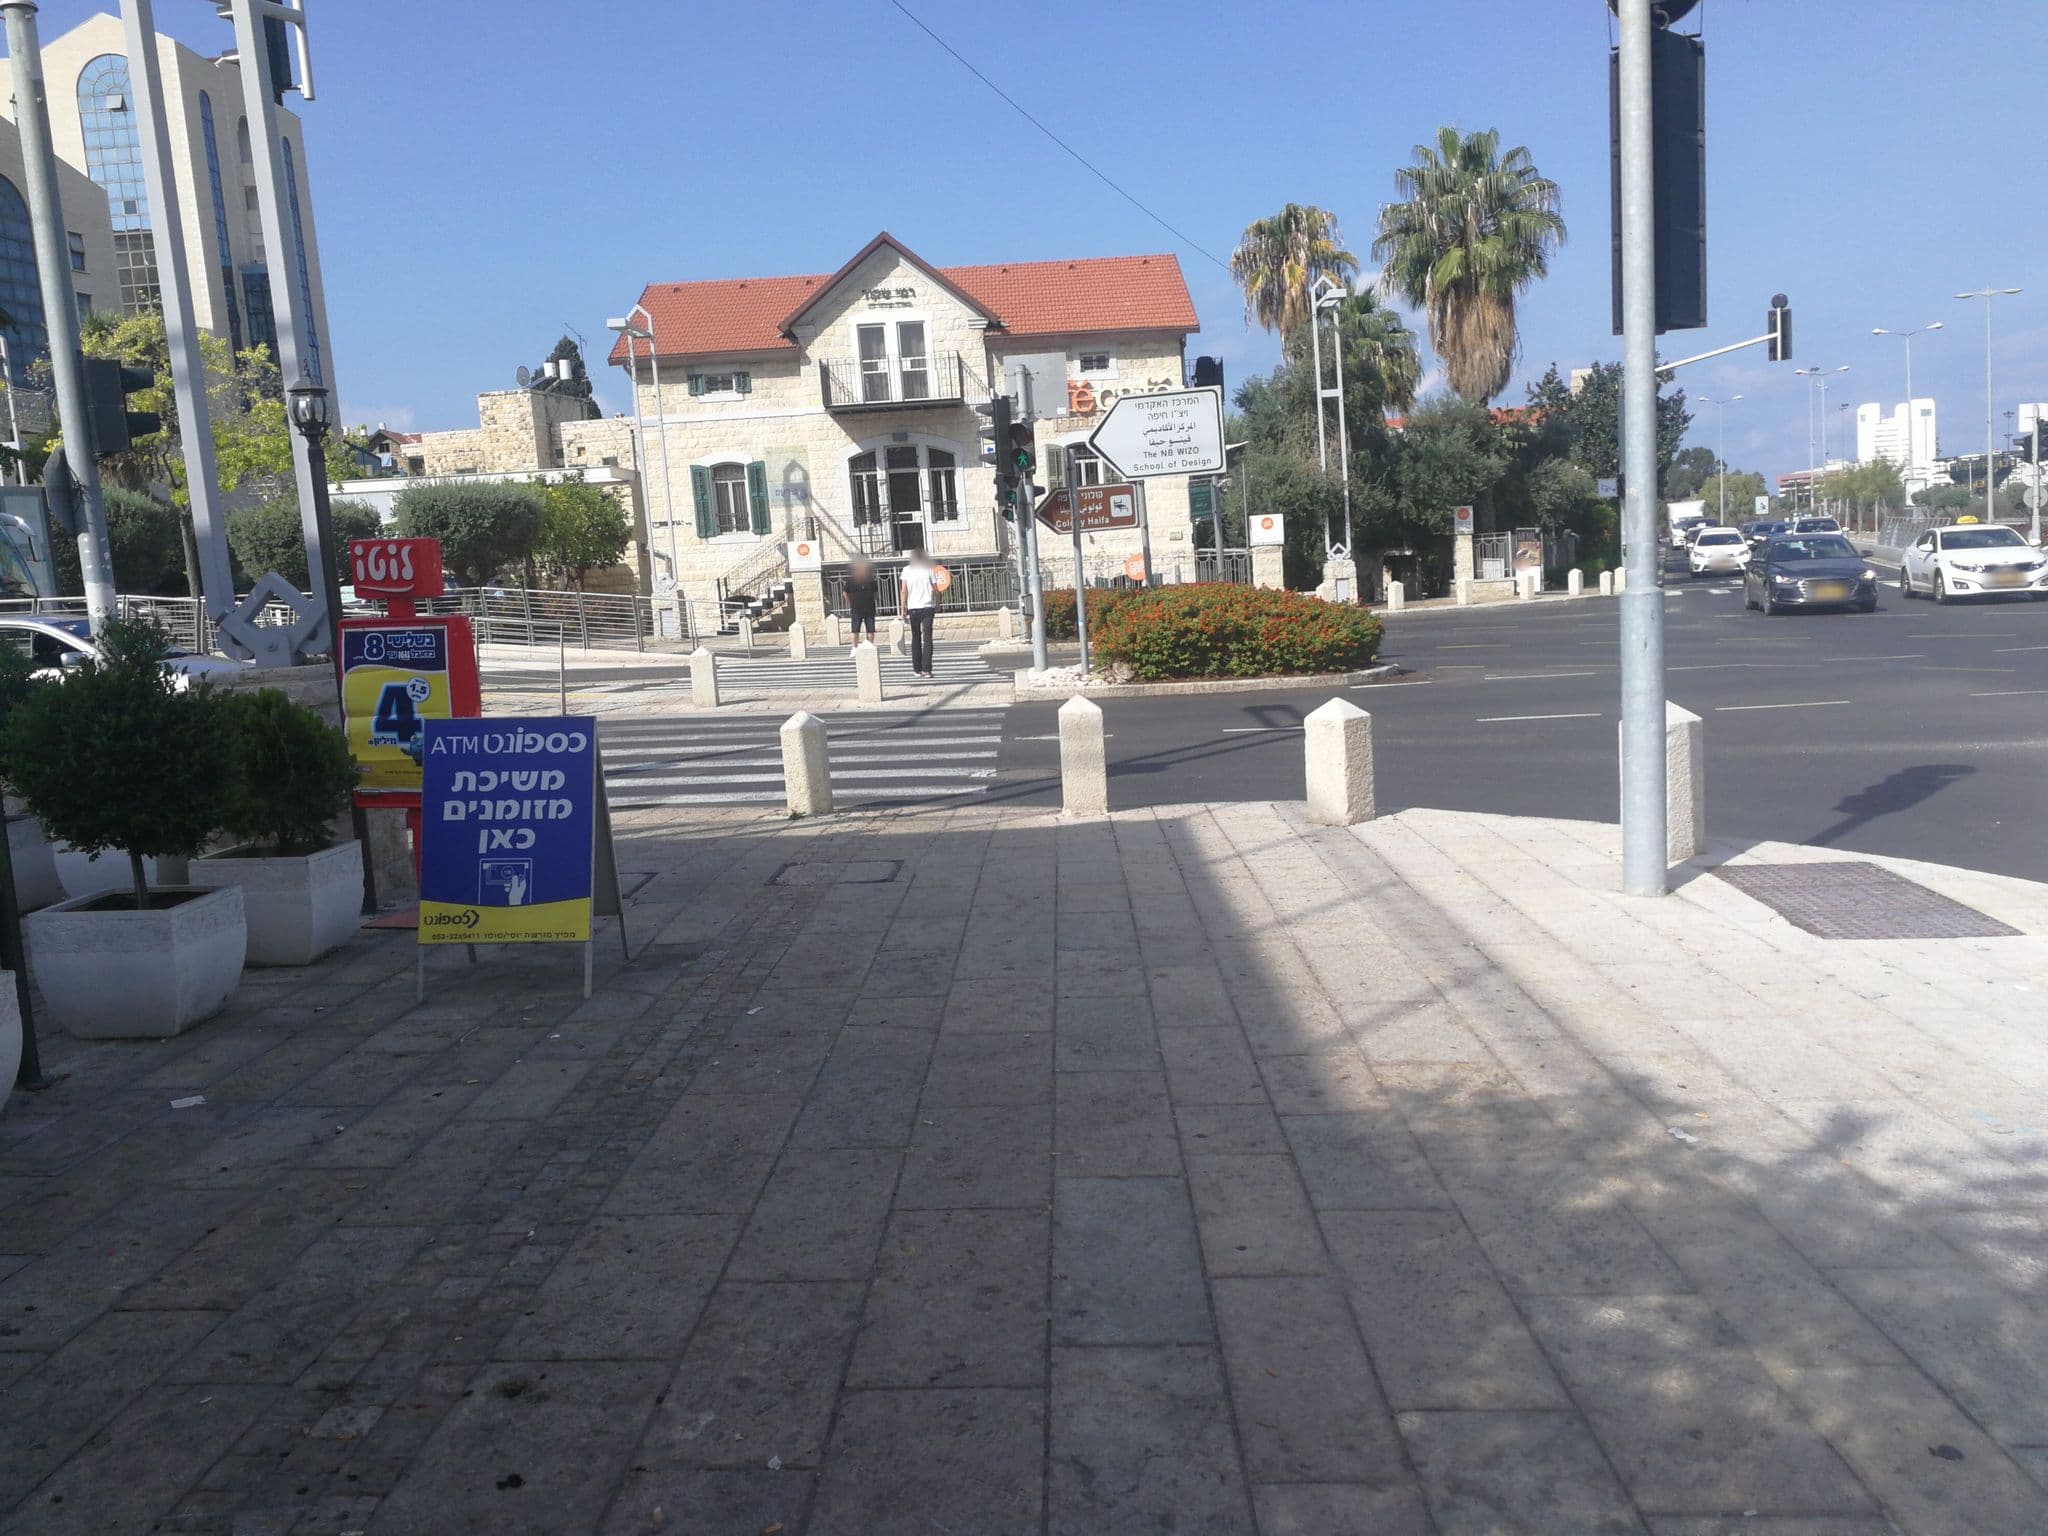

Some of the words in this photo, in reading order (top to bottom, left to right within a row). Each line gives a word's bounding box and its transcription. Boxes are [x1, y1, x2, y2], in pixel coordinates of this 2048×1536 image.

[1135, 400, 1169, 410] האקדמי
[1172, 396, 1200, 407] המרכז
[1147, 412, 1168, 421] חיפה
[1143, 451, 1157, 459] The
[1160, 448, 1174, 457] NB
[1177, 446, 1200, 455] WIZO
[1133, 462, 1164, 472] School
[1181, 458, 1212, 467] Design
[1055, 518, 1086, 528] Coly
[1087, 517, 1110, 526] Haifa
[354, 543, 414, 581] לוטו
[363, 632, 386, 661] 8
[387, 631, 436, 648] בשלישי
[409, 683, 428, 695] 1.5
[373, 684, 424, 743] 4
[430, 736, 479, 755] ATM
[451, 769, 566, 793] משיכת
[442, 798, 574, 821] מזומנים
[478, 827, 536, 854] כאן
